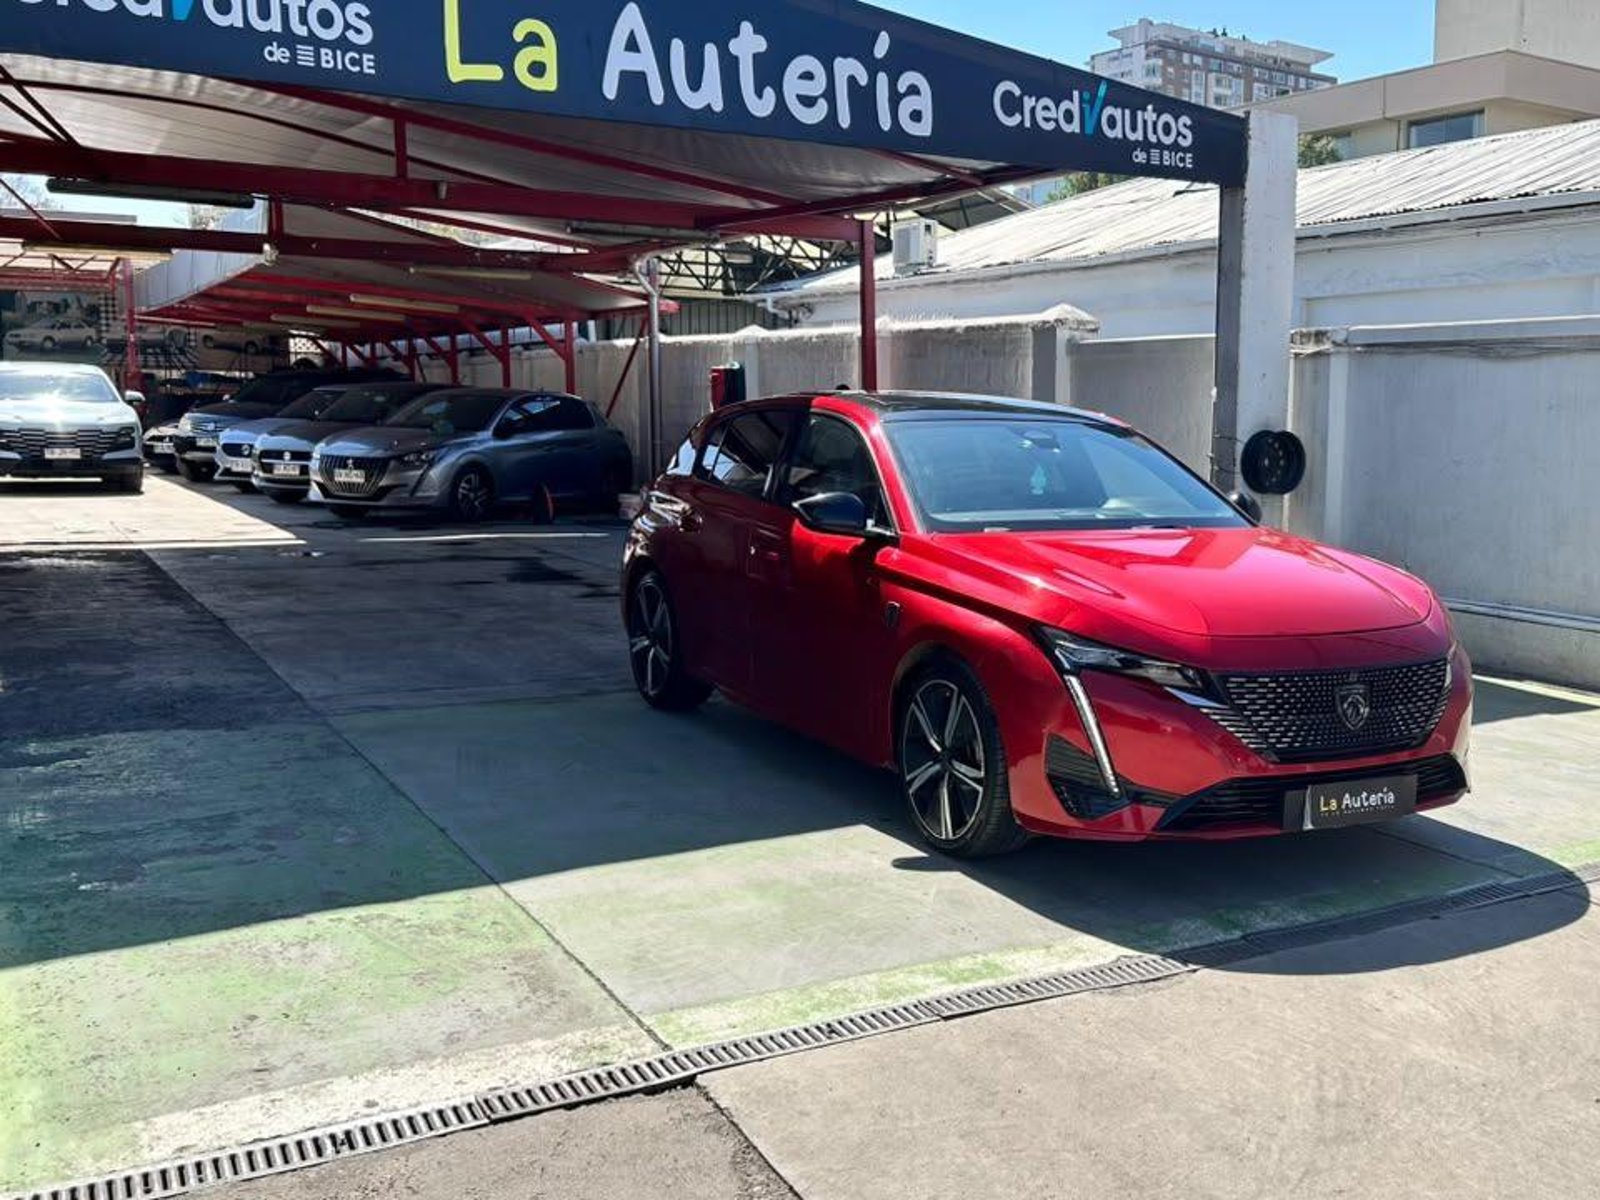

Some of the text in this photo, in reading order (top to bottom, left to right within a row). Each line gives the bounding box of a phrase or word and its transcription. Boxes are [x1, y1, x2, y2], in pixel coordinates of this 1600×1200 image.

[263, 41, 377, 74] de BICE
[443, 0, 934, 137] La Autería
[1132, 147, 1194, 168] de BICE
[1320, 795, 1338, 811] La
[1341, 786, 1395, 809] Autería
